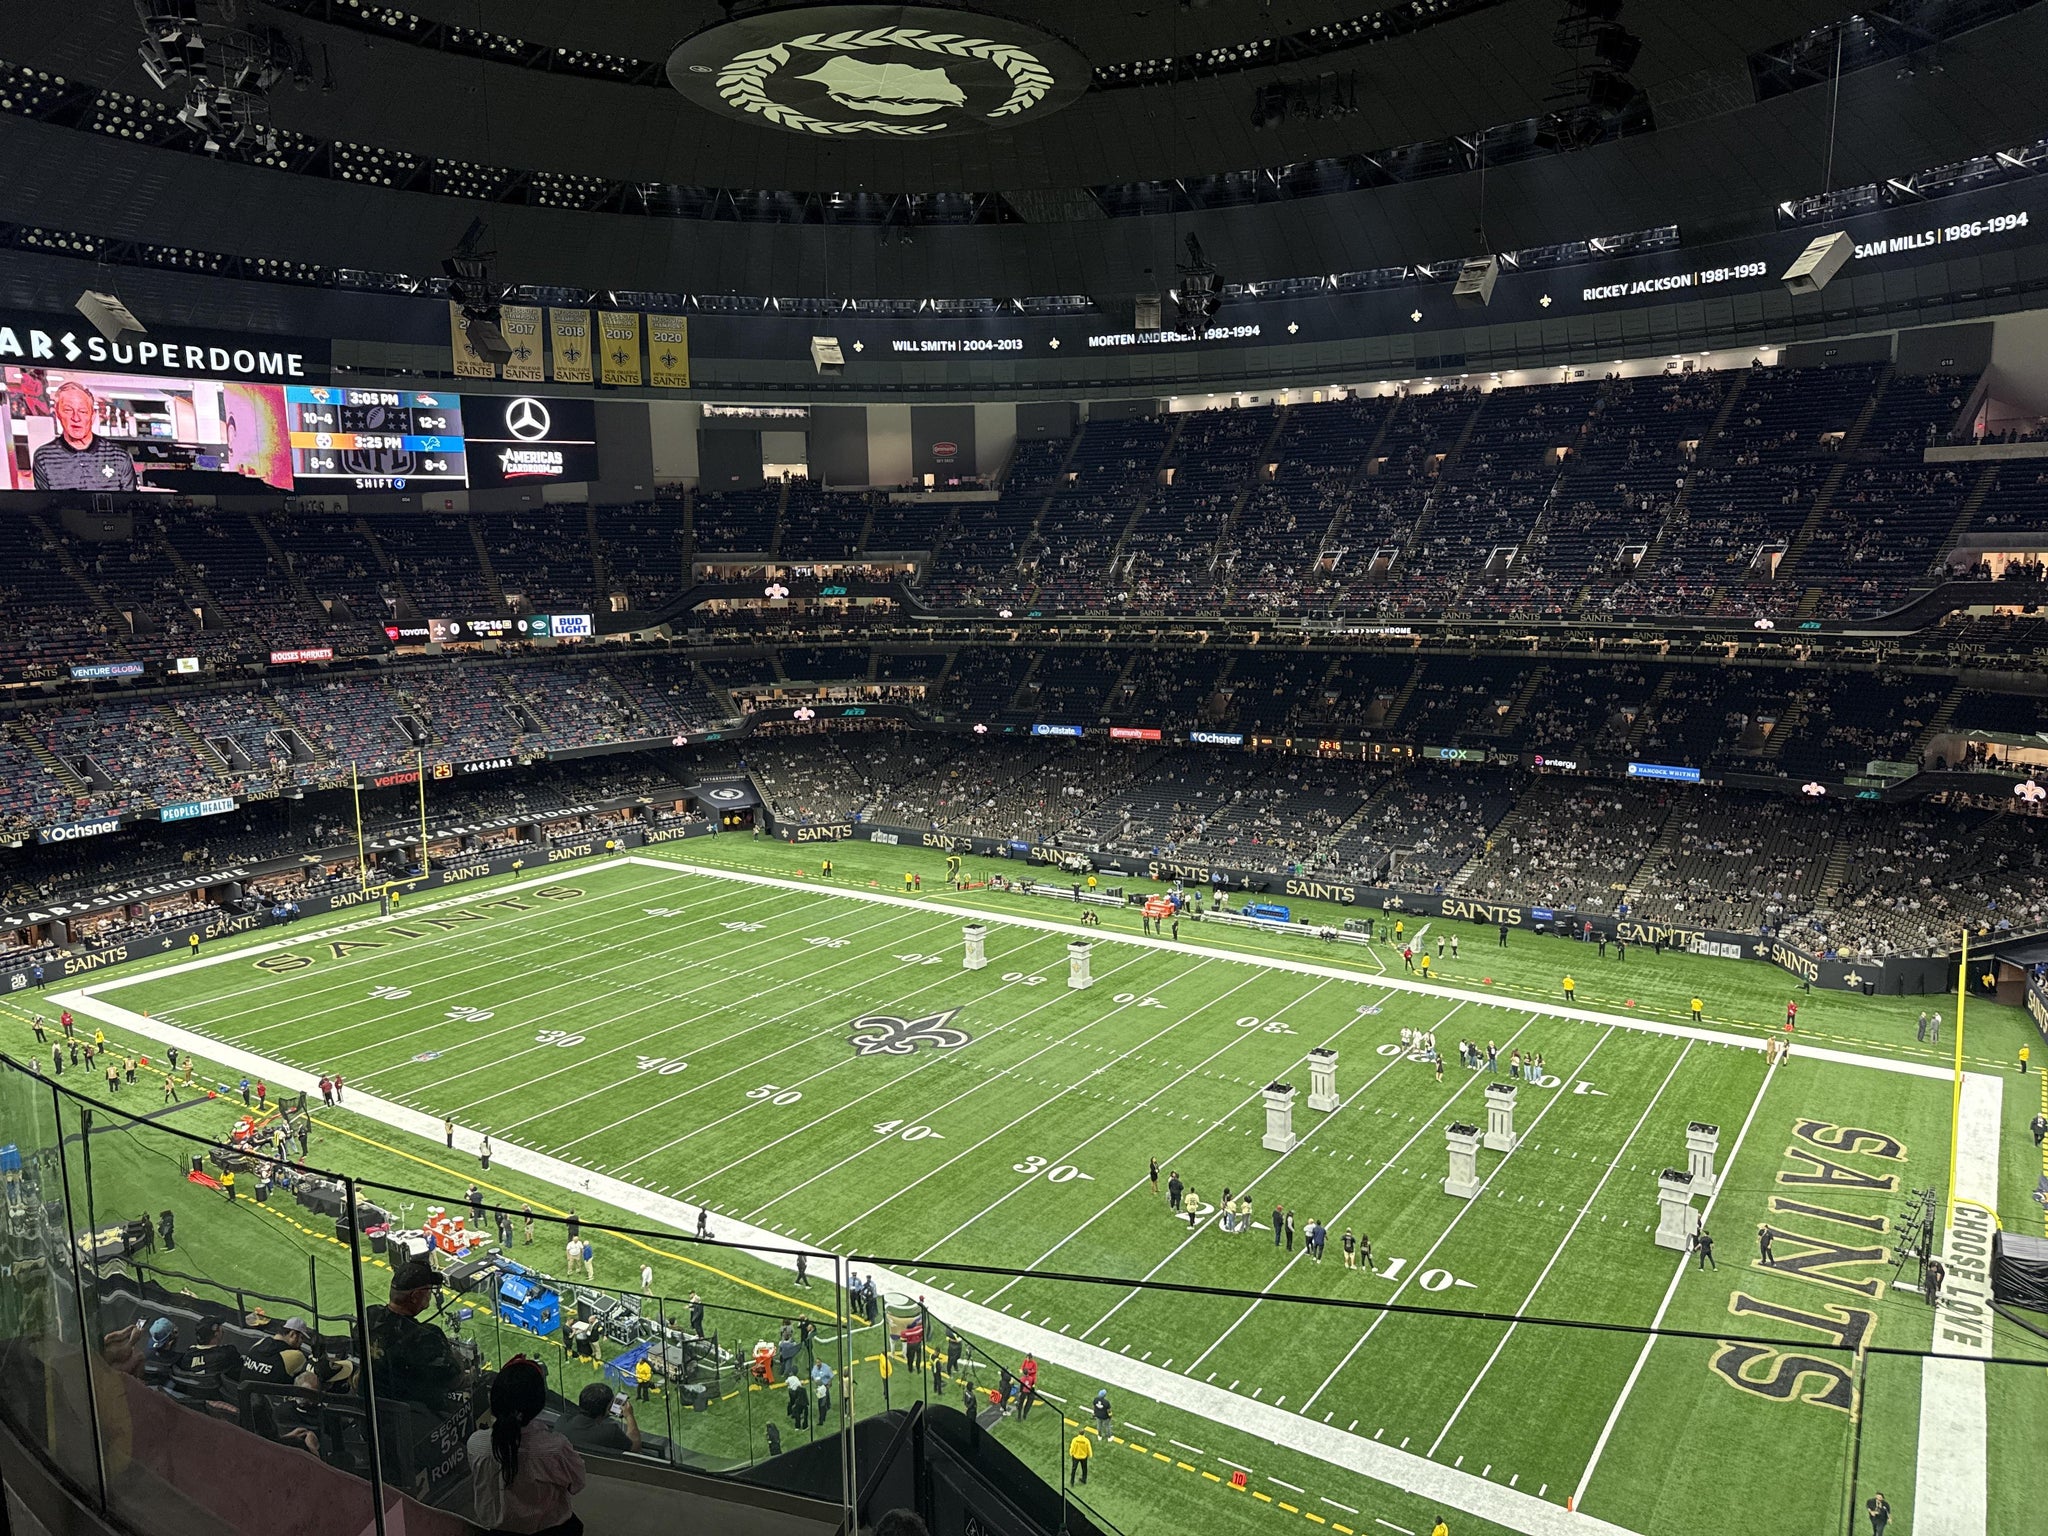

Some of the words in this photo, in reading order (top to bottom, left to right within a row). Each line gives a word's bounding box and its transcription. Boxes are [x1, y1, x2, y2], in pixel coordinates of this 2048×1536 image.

[1855, 242, 1887, 259] SAM
[1889, 231, 1935, 257] MILLS
[1944, 211, 2028, 242] 1986-1994
[1583, 284, 1628, 301] RICKEY
[1630, 274, 1692, 296] JACKSON
[1700, 262, 1767, 284] 1981-1993
[507, 323, 535, 336] 2017
[557, 326, 585, 337] 2018
[606, 329, 632, 340] 2019
[654, 332, 682, 343] 2020
[1088, 334, 1135, 346] MORTEN
[892, 340, 919, 352] WILL
[920, 340, 956, 352] SMITH
[963, 339, 1023, 350] 2004-2013
[87, 336, 305, 377] SUPERDOME
[456, 365, 493, 377] SAINTS
[505, 369, 541, 380] SAINTS
[556, 371, 592, 381] SAINTS
[604, 374, 639, 384] SAINTS
[653, 376, 687, 387] SAINTS
[350, 393, 377, 405] 3:05
[380, 394, 399, 406] PM
[303, 412, 333, 425] 10-4
[418, 416, 446, 429] 12-2
[354, 436, 382, 448] 3:25
[384, 437, 402, 449] PM
[504, 448, 563, 464] AMERICAS
[310, 457, 335, 469] 8-6
[424, 459, 448, 471] 8-6
[820, 585, 848, 596] JETS
[559, 617, 583, 626] BUD
[1441, 611, 1472, 620] SAINTS
[1508, 612, 1541, 621] SAINTS
[1580, 613, 1614, 623] SAINTS
[400, 628, 430, 636] TOYOTA
[450, 622, 460, 635] 0
[473, 620, 503, 631] 22:16
[517, 620, 528, 632] 0
[554, 625, 589, 634] LIGHT
[1799, 621, 1822, 630] JETS
[1704, 633, 1739, 643] SAINTS
[1781, 635, 1817, 646] SAINTS
[1861, 639, 1900, 649] SAINTS
[1946, 641, 1986, 653] SAINTS
[205, 654, 238, 665] SAINTS
[271, 651, 299, 662] ROUSES
[300, 648, 332, 660] MARKETS
[21, 668, 58, 680] SAINTS
[72, 667, 110, 678] VENTURE
[111, 664, 143, 674] GLOBAL
[1050, 727, 1076, 736] Allstate
[1198, 733, 1242, 745] Ochsner
[1319, 740, 1340, 750] 22:16
[519, 752, 546, 762] SAINTS
[1440, 748, 1467, 760] COX
[463, 758, 513, 772] CAESARS
[1544, 758, 1577, 770] entergy
[435, 765, 451, 778] 25
[317, 780, 349, 791] SAINTS
[373, 771, 420, 787] verizon
[247, 790, 280, 802] SAINTS
[163, 805, 200, 820] PEOPLES
[202, 799, 234, 813] HEALTH
[482, 804, 599, 829] SUPERDOME
[51, 820, 119, 842] Ochsner
[648, 826, 685, 843] SAINTS
[797, 824, 852, 841] SAINTS
[922, 832, 972, 850] SAINS
[548, 844, 592, 862] SAINTS
[443, 864, 490, 883] SAINTS
[92, 867, 250, 907] SUPERDOME
[1285, 879, 1355, 902] SAINTS
[330, 889, 380, 909] SAINTS
[1442, 898, 1522, 925] SAINTS
[308, 918, 385, 938] TAKES
[391, 907, 431, 919] ALL
[252, 886, 586, 974] SAINTS
[64, 946, 128, 975] SAINTS
[1772, 942, 1819, 983] SAINTS
[369, 986, 411, 1000] 10
[444, 1006, 495, 1023] 20
[2027, 988, 2048, 1034] SAINTS
[535, 1030, 586, 1048] 30
[636, 1056, 689, 1075] 40
[746, 1084, 802, 1106] 50
[872, 1119, 932, 1142] 40
[1013, 1155, 1079, 1183] 30
[443, 1238, 450, 1250] G
[1947, 1206, 1989, 1283] CHOOSE
[1376, 1256, 1453, 1291] 10
[1708, 1118, 1909, 1421] SAINTS
[1942, 1285, 1984, 1348] LOVE
[430, 1401, 472, 1443] SECTION
[441, 1417, 468, 1454] 537
[431, 1447, 464, 1483] ROWS
[1234, 1472, 1245, 1485] 10
